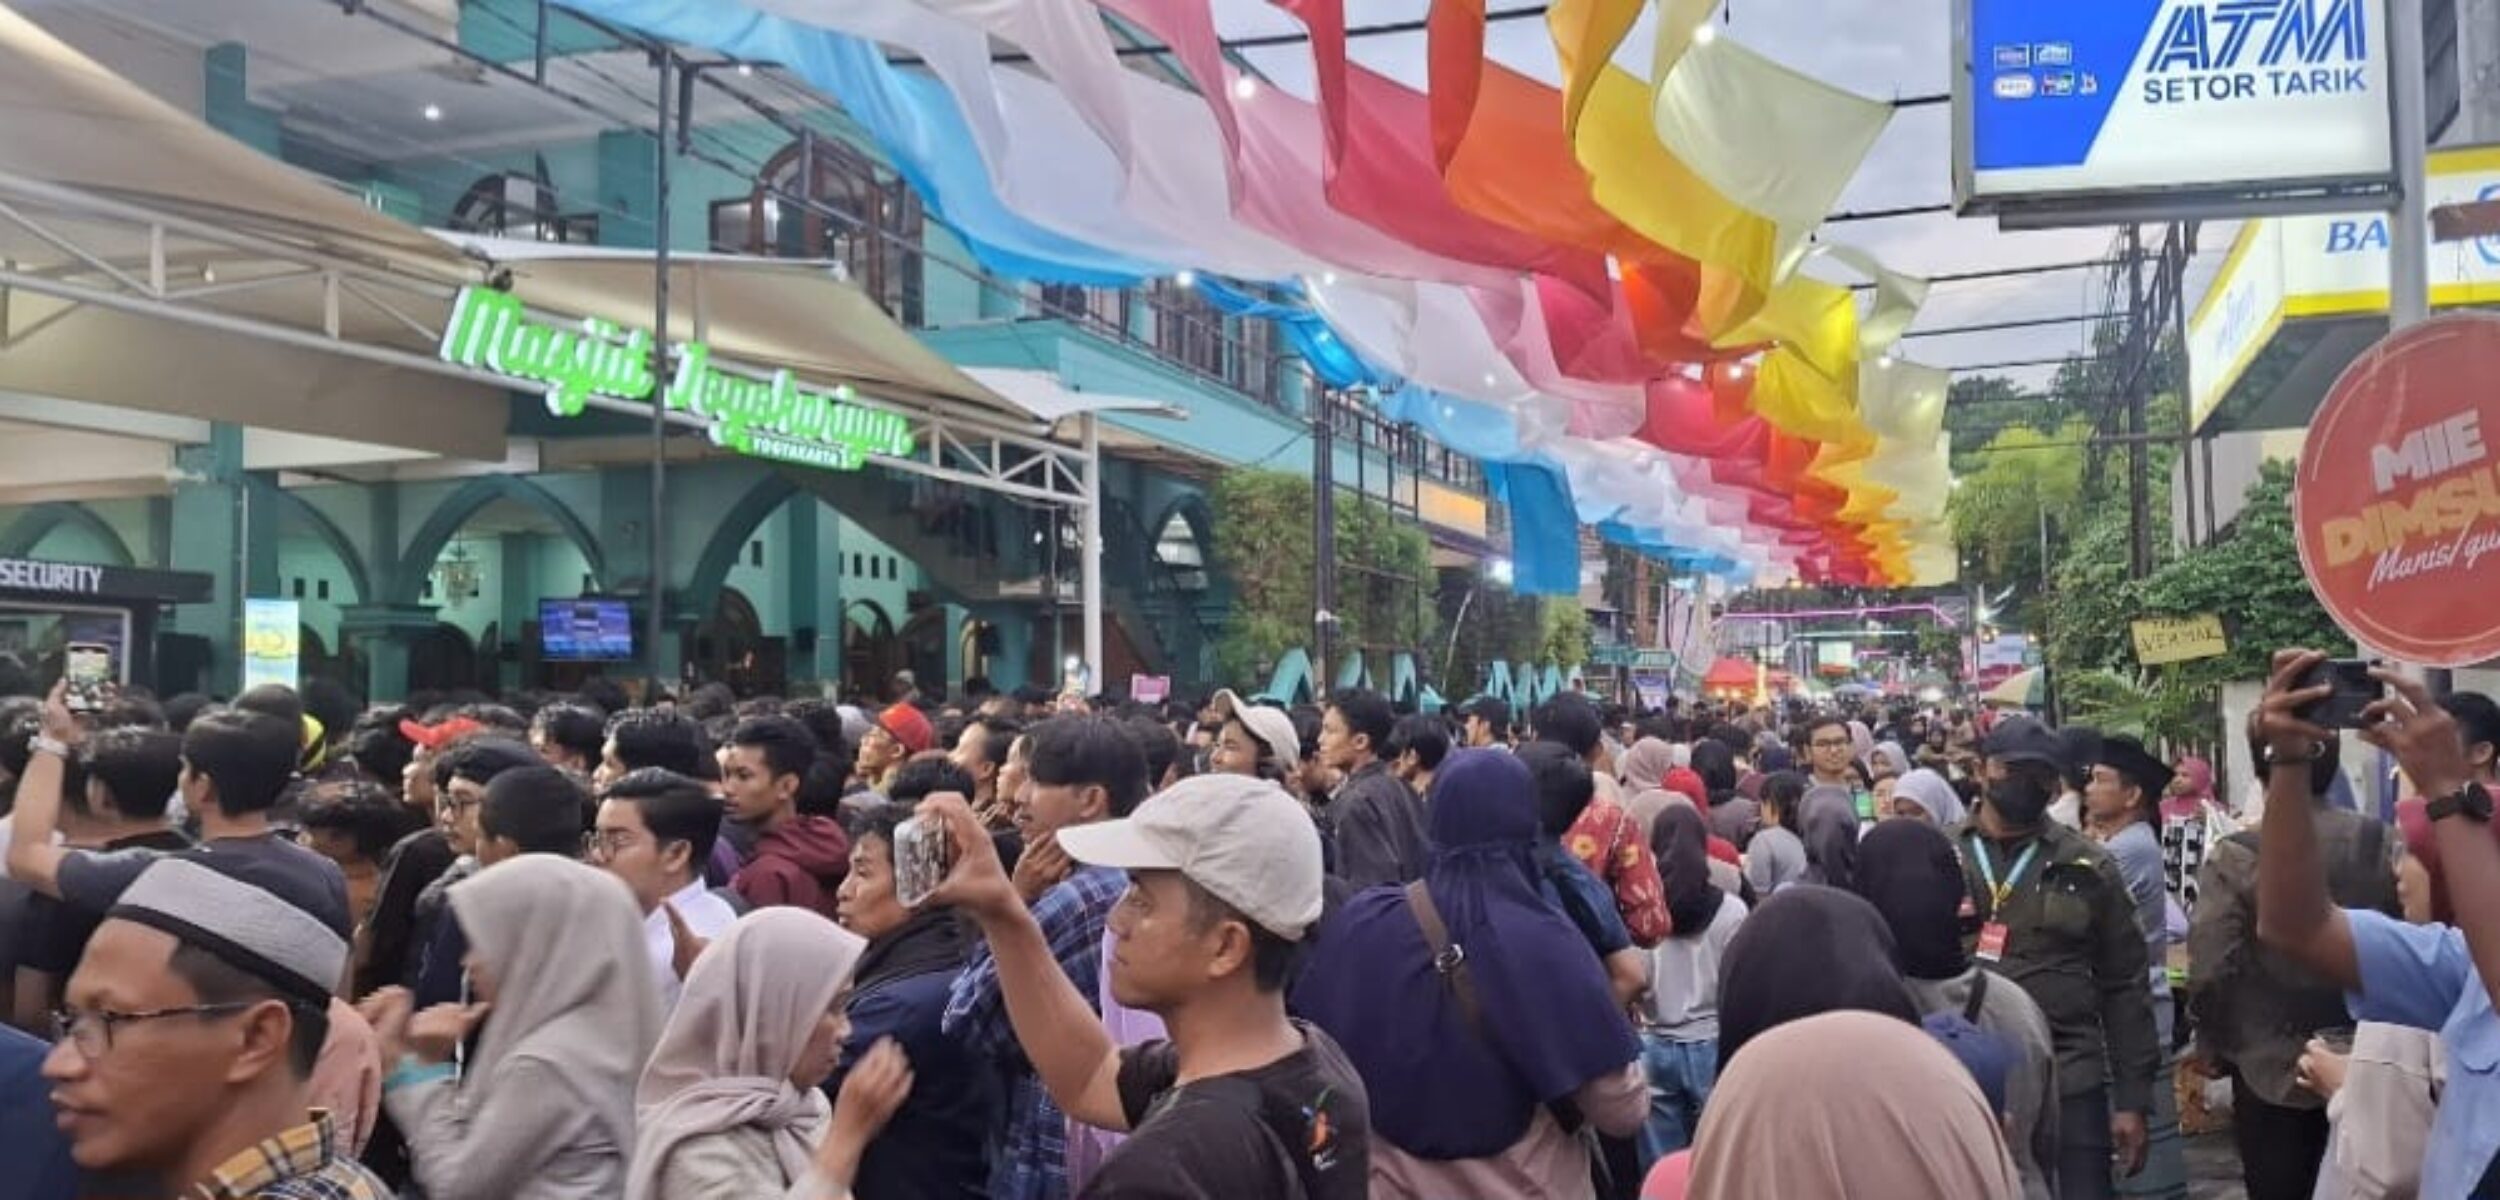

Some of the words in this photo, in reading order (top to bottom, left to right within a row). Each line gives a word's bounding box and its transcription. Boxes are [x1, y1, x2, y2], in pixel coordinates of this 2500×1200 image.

[2147, 0, 2366, 72] ATM
[2143, 73, 2256, 103] SETOR
[2267, 67, 2366, 95] TARIK
[440, 284, 655, 417] Masjid
[752, 437, 842, 469] YOGYAKARTA
[2372, 408, 2487, 494] MIE
[0, 558, 103, 593] SECURITY
